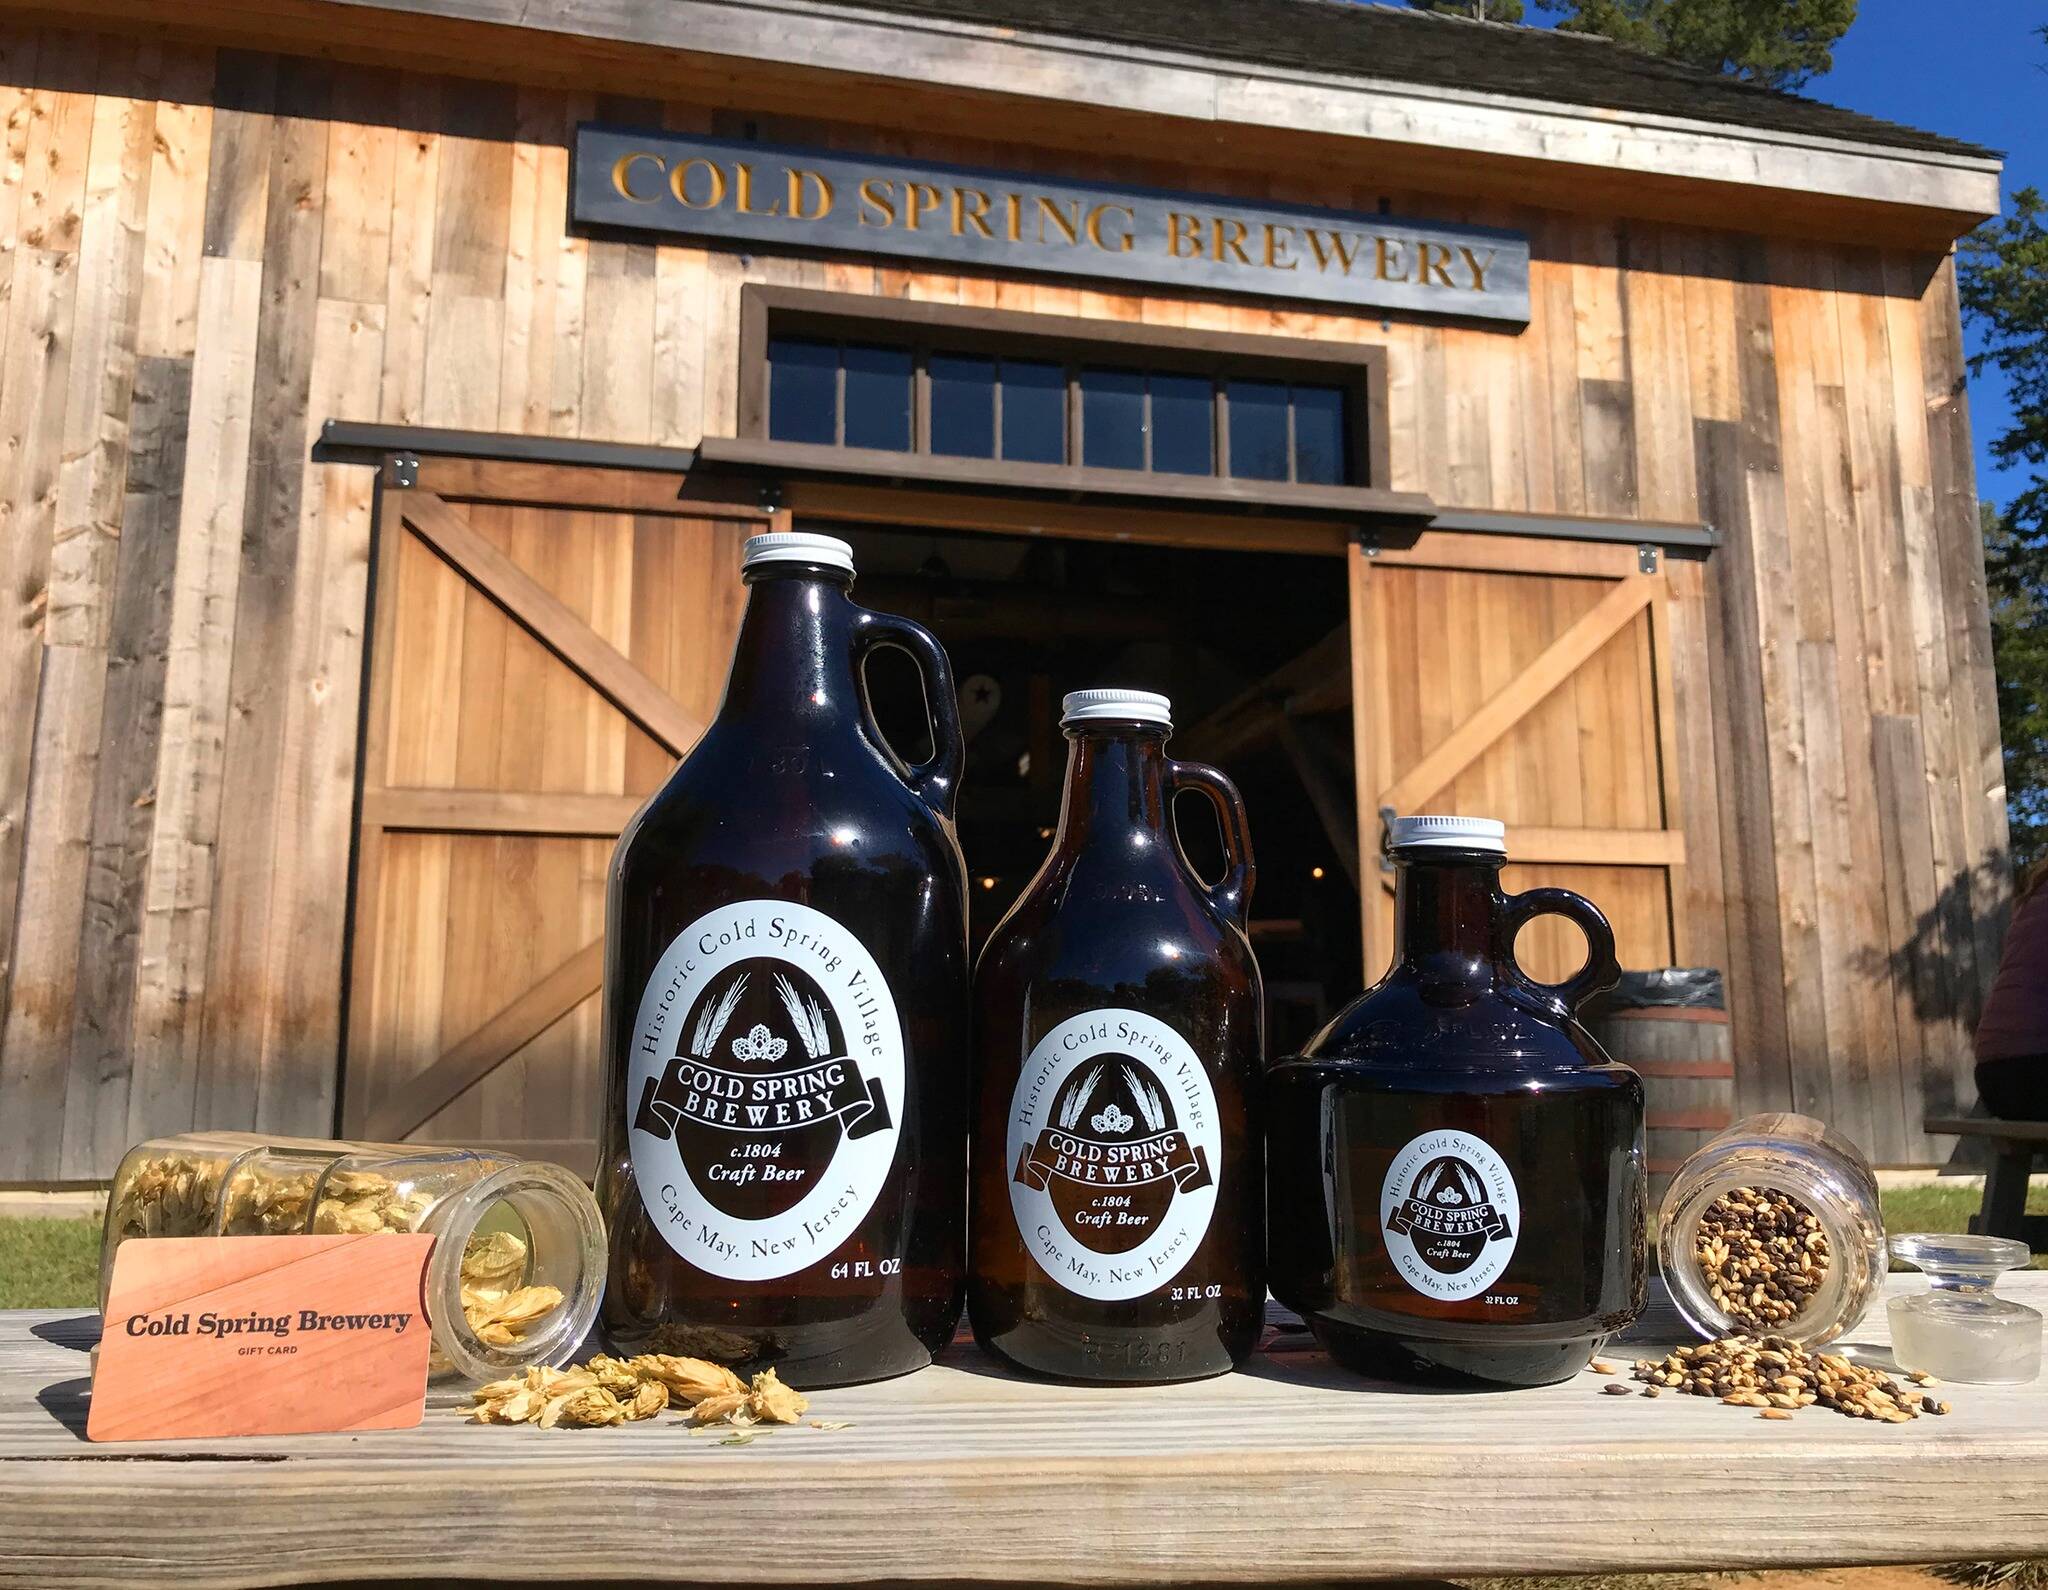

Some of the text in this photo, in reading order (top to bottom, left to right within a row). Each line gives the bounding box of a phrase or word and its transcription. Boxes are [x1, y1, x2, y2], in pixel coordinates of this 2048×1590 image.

[611, 151, 1496, 291] COLD SPRING BREWERY
[643, 917, 883, 1057] Historic Cold Spring Village
[677, 1064, 846, 1101] COLD SPRING
[1018, 1022, 1204, 1130] Historic Cold Spring Village
[684, 1091, 835, 1126] BREWERY
[730, 1143, 782, 1159] c.1804
[1048, 1135, 1177, 1163] COLD SPRING
[708, 1164, 805, 1186] Craft Beer
[1054, 1155, 1171, 1183] BREWERY
[1389, 1138, 1507, 1205] Historic Cold Spring Village
[1091, 1195, 1131, 1207] c.1804
[1410, 1202, 1489, 1221] COLD SPRING
[661, 1183, 692, 1232] Cape
[751, 1237, 797, 1258] New
[801, 1185, 860, 1245] Jersey
[1075, 1211, 1149, 1229] Craft Beer
[1414, 1215, 1485, 1233] BREWERY
[1036, 1224, 1063, 1262] Cape
[1109, 1265, 1144, 1284] New
[1149, 1226, 1189, 1274] Jersey
[1426, 1248, 1471, 1259] Craft Beer
[831, 1258, 901, 1279] 64 FL OZ
[1402, 1255, 1420, 1277] Cape
[1447, 1282, 1468, 1292] New
[1470, 1260, 1495, 1287] Jersey
[1170, 1284, 1222, 1301] 32 FL OZ
[1485, 1296, 1518, 1305] 32 FL OZ
[126, 1310, 413, 1339] Cold Spring Brewery
[238, 1345, 298, 1356] GIFT CARD
